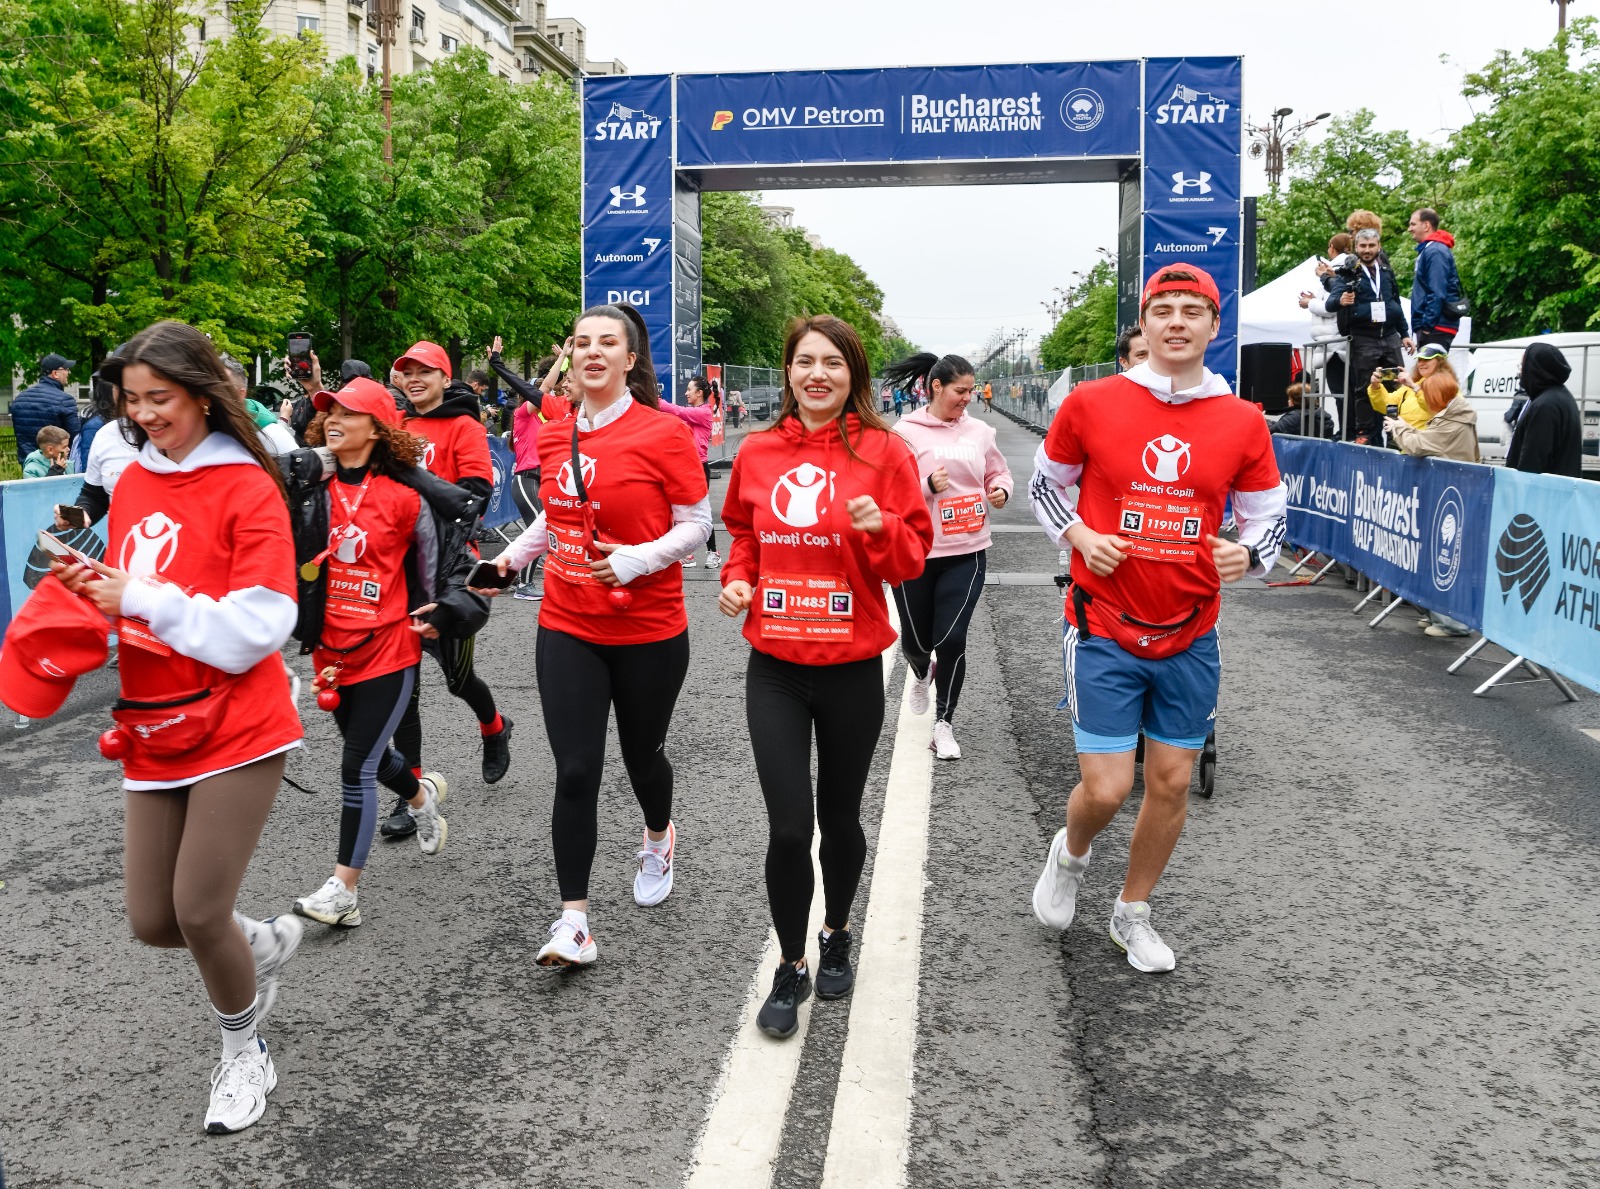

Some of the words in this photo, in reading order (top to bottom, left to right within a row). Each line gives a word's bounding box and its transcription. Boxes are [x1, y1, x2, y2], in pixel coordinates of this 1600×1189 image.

[911, 92, 1041, 118] Bucharest
[1155, 104, 1230, 124] START
[742, 107, 797, 127] OMV
[804, 106, 885, 125] Petrom
[911, 117, 950, 134] HALF
[953, 115, 1042, 132] MARATHON
[595, 121, 662, 141] START
[1154, 242, 1208, 253] Autonom
[594, 253, 644, 263] Autonom
[607, 290, 650, 306] DIGI
[934, 446, 977, 460] PUMA
[1283, 472, 1305, 505] OMV
[1309, 476, 1348, 516] Petrom
[1354, 470, 1420, 539] Bucharest
[1147, 518, 1181, 532] 11910
[1352, 518, 1374, 552] HALF
[1372, 525, 1420, 574] MARATHON
[1562, 532, 1600, 580] WOR
[330, 580, 360, 592] 11914
[789, 595, 827, 609] 11485
[1554, 581, 1600, 633] ATHL
